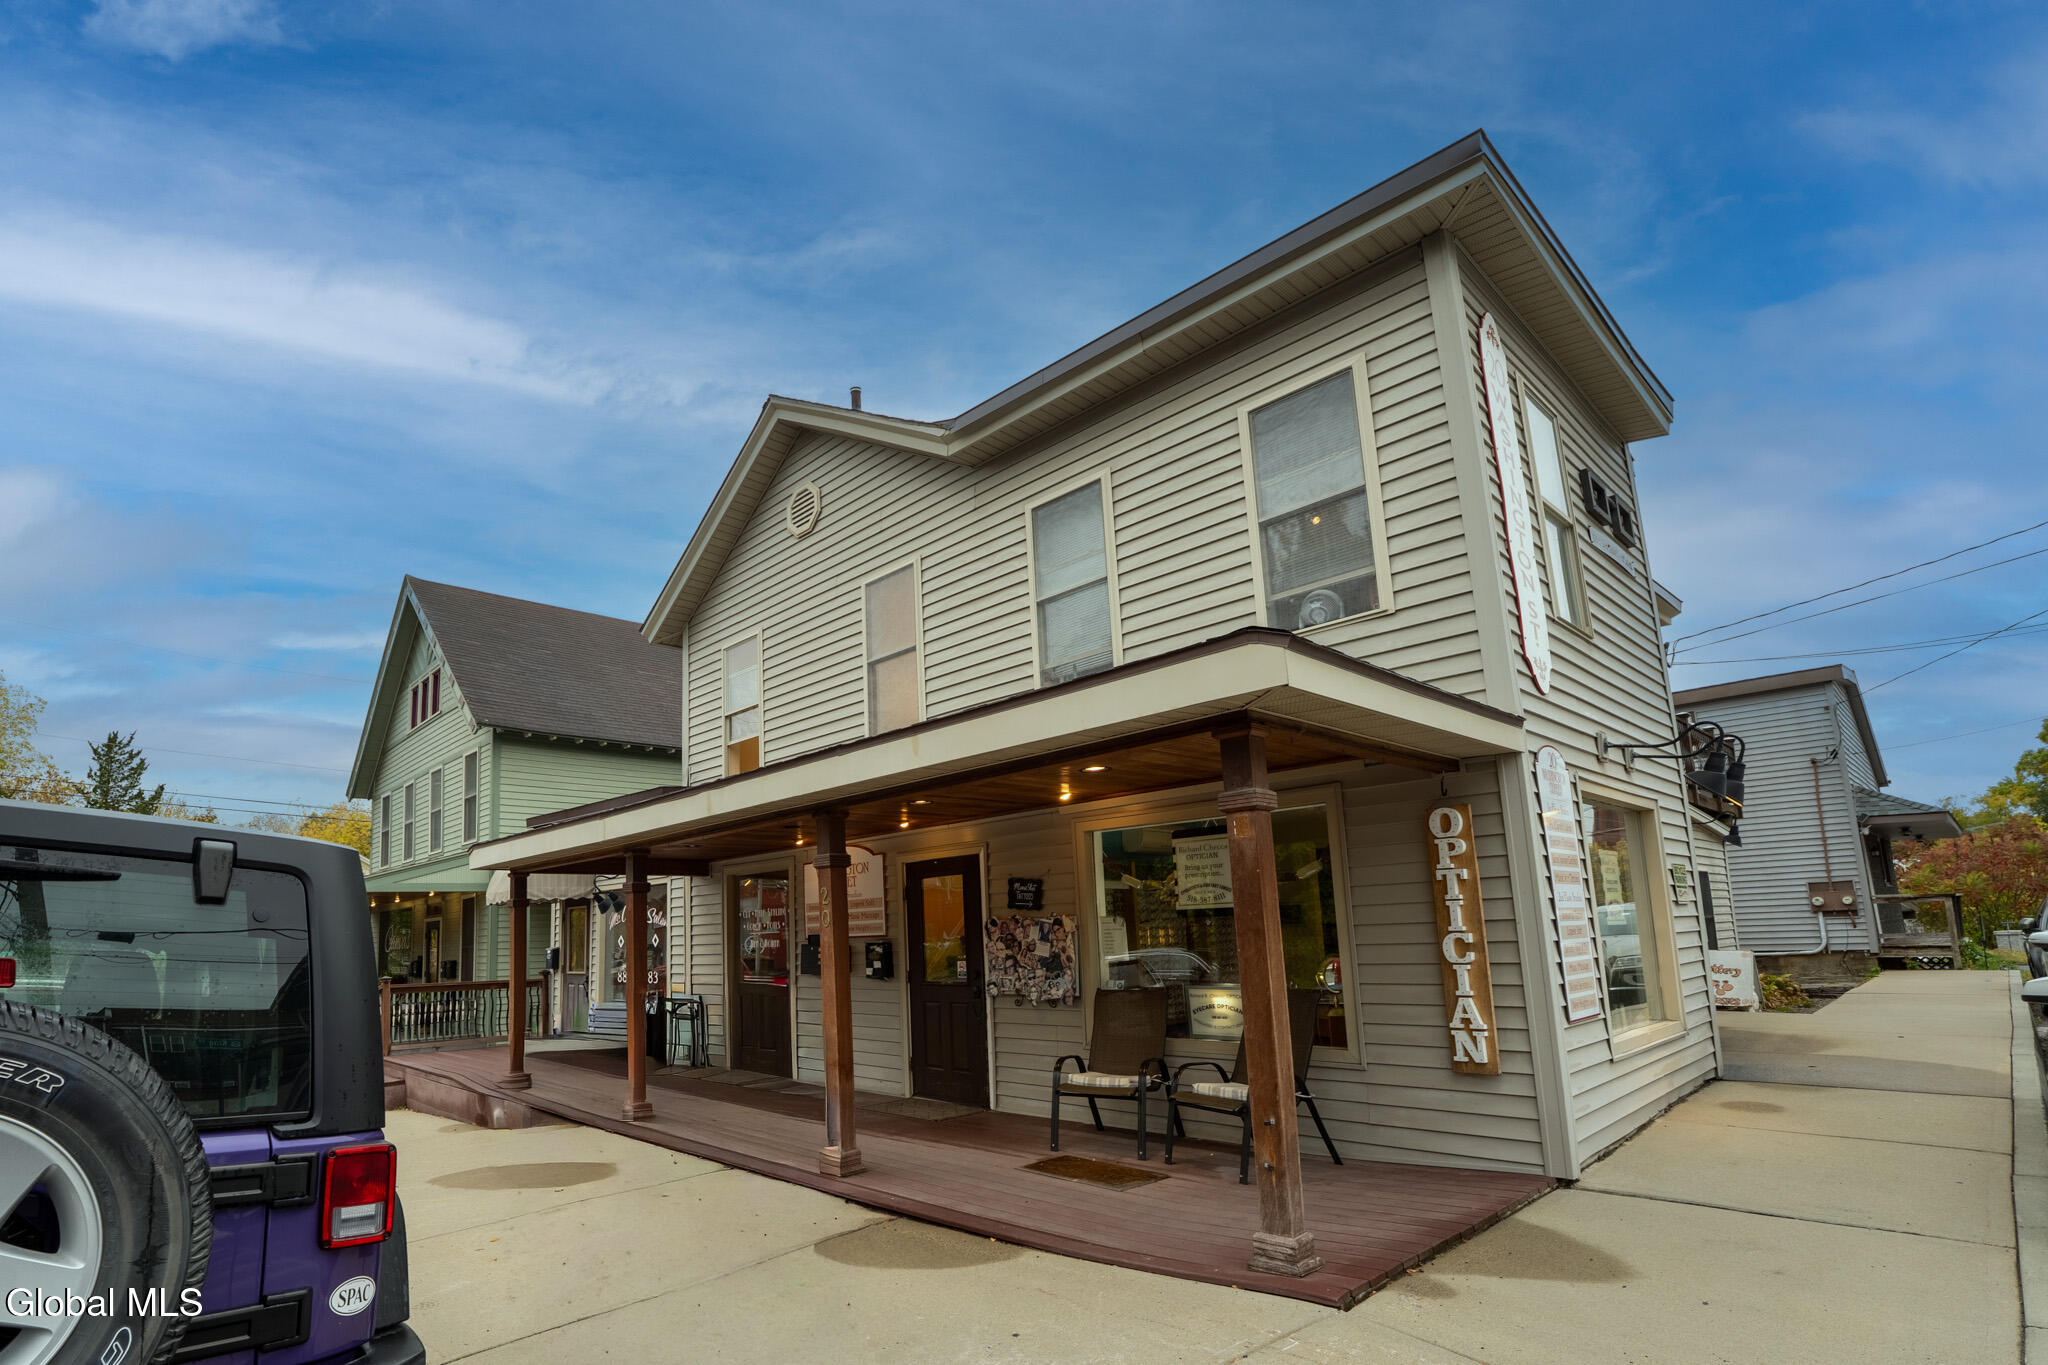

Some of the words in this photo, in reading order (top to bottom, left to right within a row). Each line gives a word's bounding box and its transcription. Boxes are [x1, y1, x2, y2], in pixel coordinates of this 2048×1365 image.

[1491, 383, 1535, 594] WASHINGTON
[1186, 852, 1219, 861] OPTICIAN
[819, 887, 831, 929] 20
[1428, 807, 1489, 1064] OPTICIAN
[1192, 1003, 1216, 1015] EYECARE
[337, 1283, 371, 1308] SPAC
